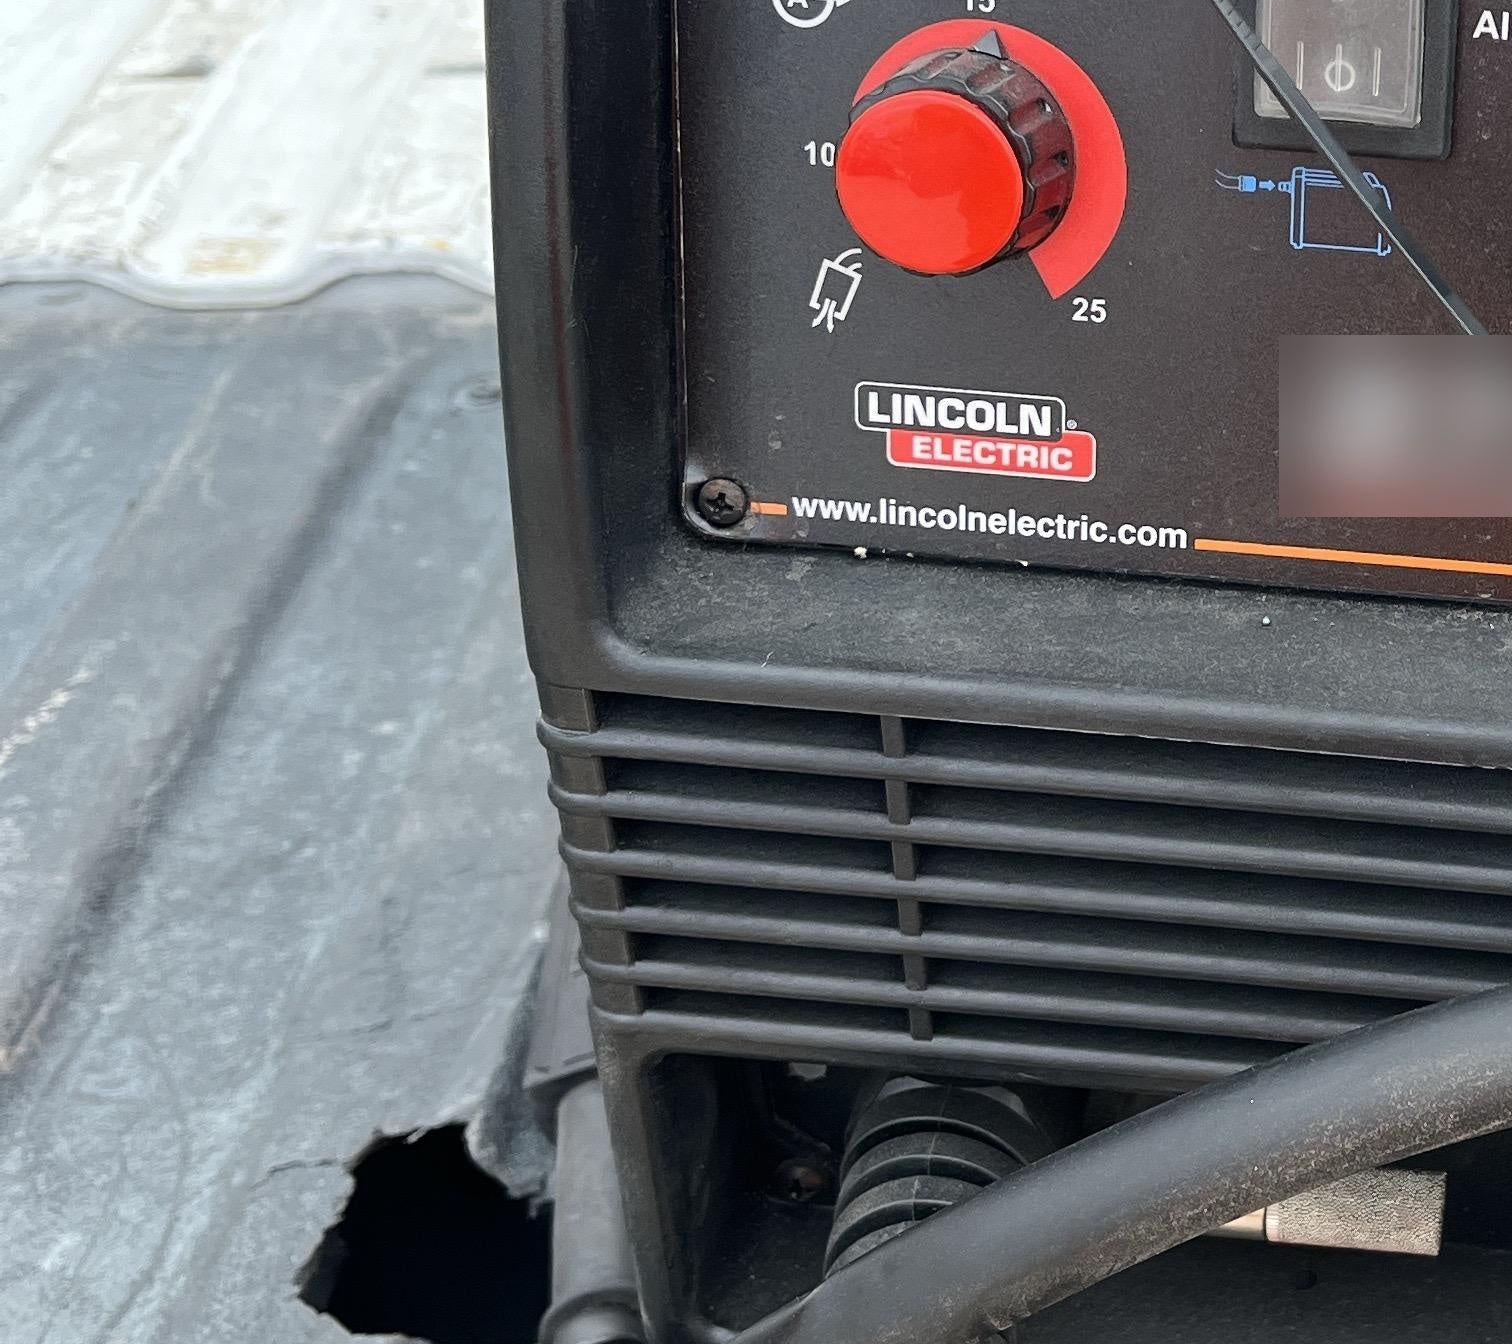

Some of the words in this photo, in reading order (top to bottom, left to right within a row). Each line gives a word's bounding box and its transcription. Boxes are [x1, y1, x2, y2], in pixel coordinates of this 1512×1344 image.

[804, 140, 836, 167] 10
[1071, 297, 1107, 323] 25
[867, 391, 1053, 437] LINCOLN
[911, 436, 1073, 472] ELECTRIC
[791, 496, 1188, 550] www.lincolnelectric.com
